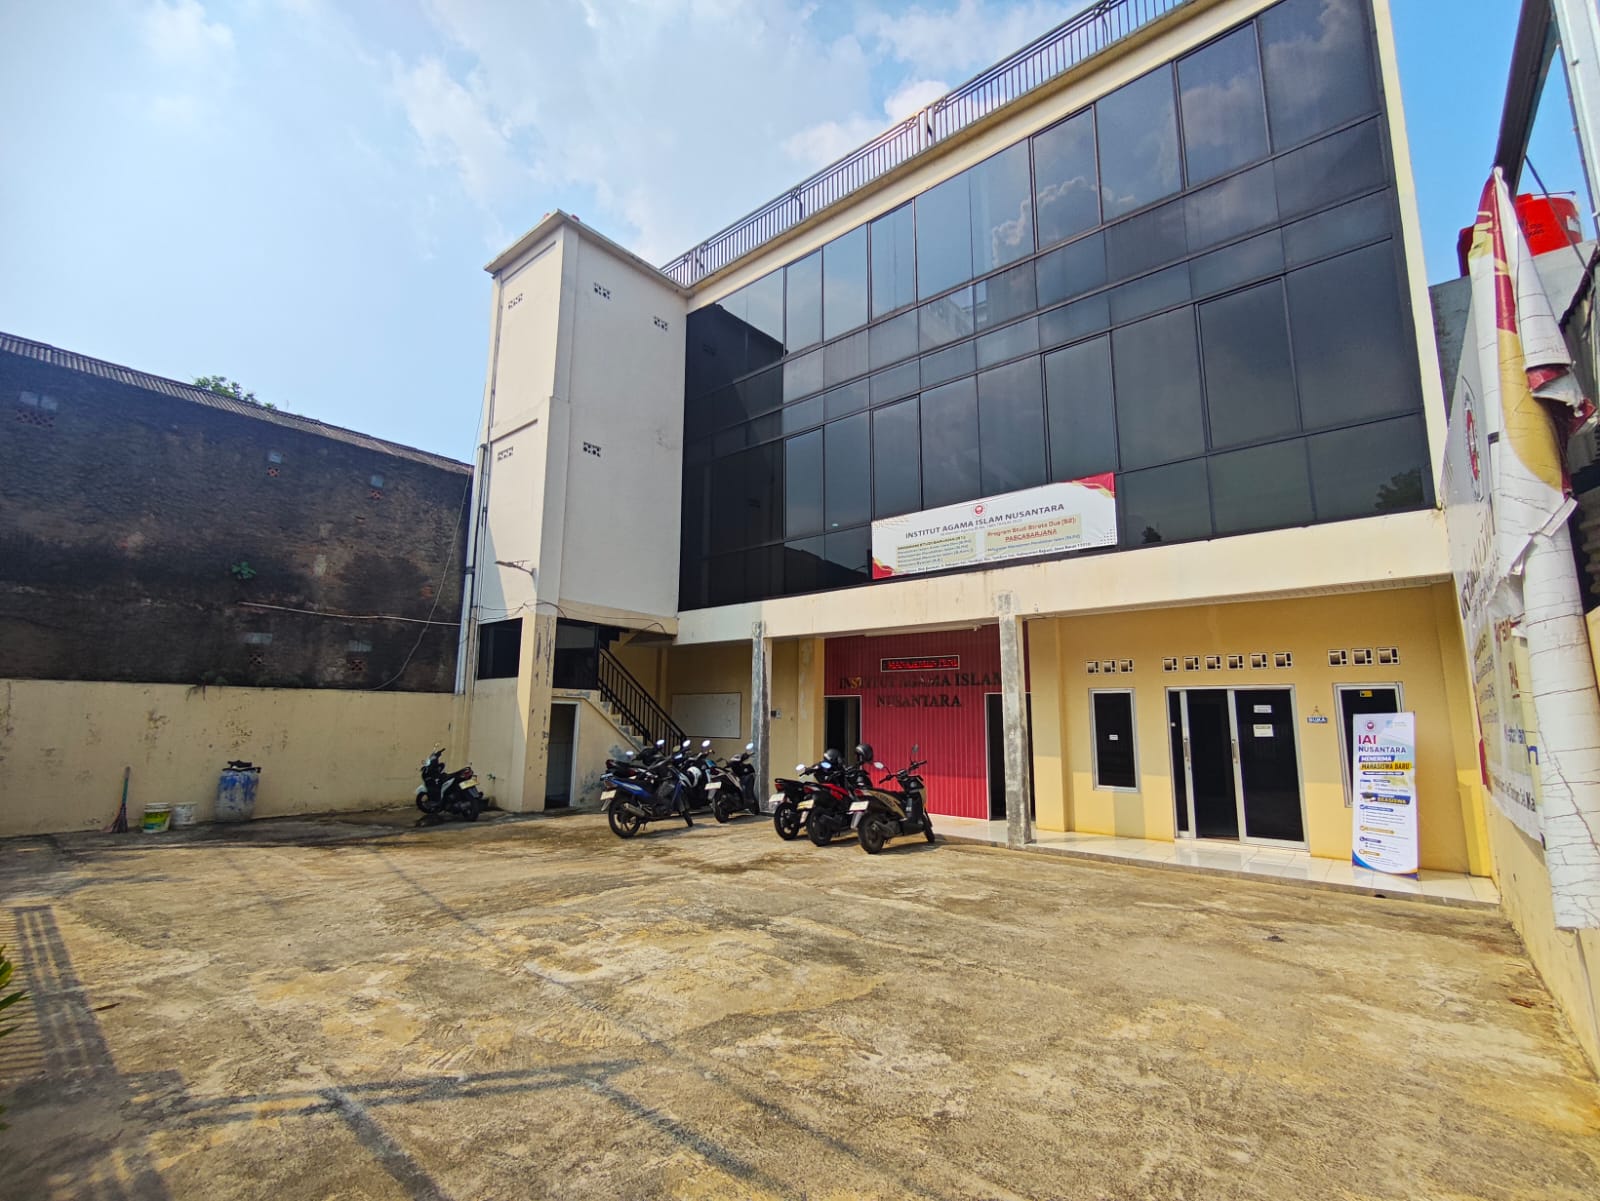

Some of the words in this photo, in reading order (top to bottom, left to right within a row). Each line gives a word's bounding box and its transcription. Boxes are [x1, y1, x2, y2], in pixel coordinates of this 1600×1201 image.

[905, 527, 940, 539] INSTITUT
[942, 520, 974, 532] AGAMA
[975, 515, 1003, 527] ISLAM
[1005, 503, 1065, 520] NUSANTARA
[877, 693, 962, 707] NUSANTARA
[1358, 735, 1376, 744] IAI
[1394, 762, 1410, 770] BARU
